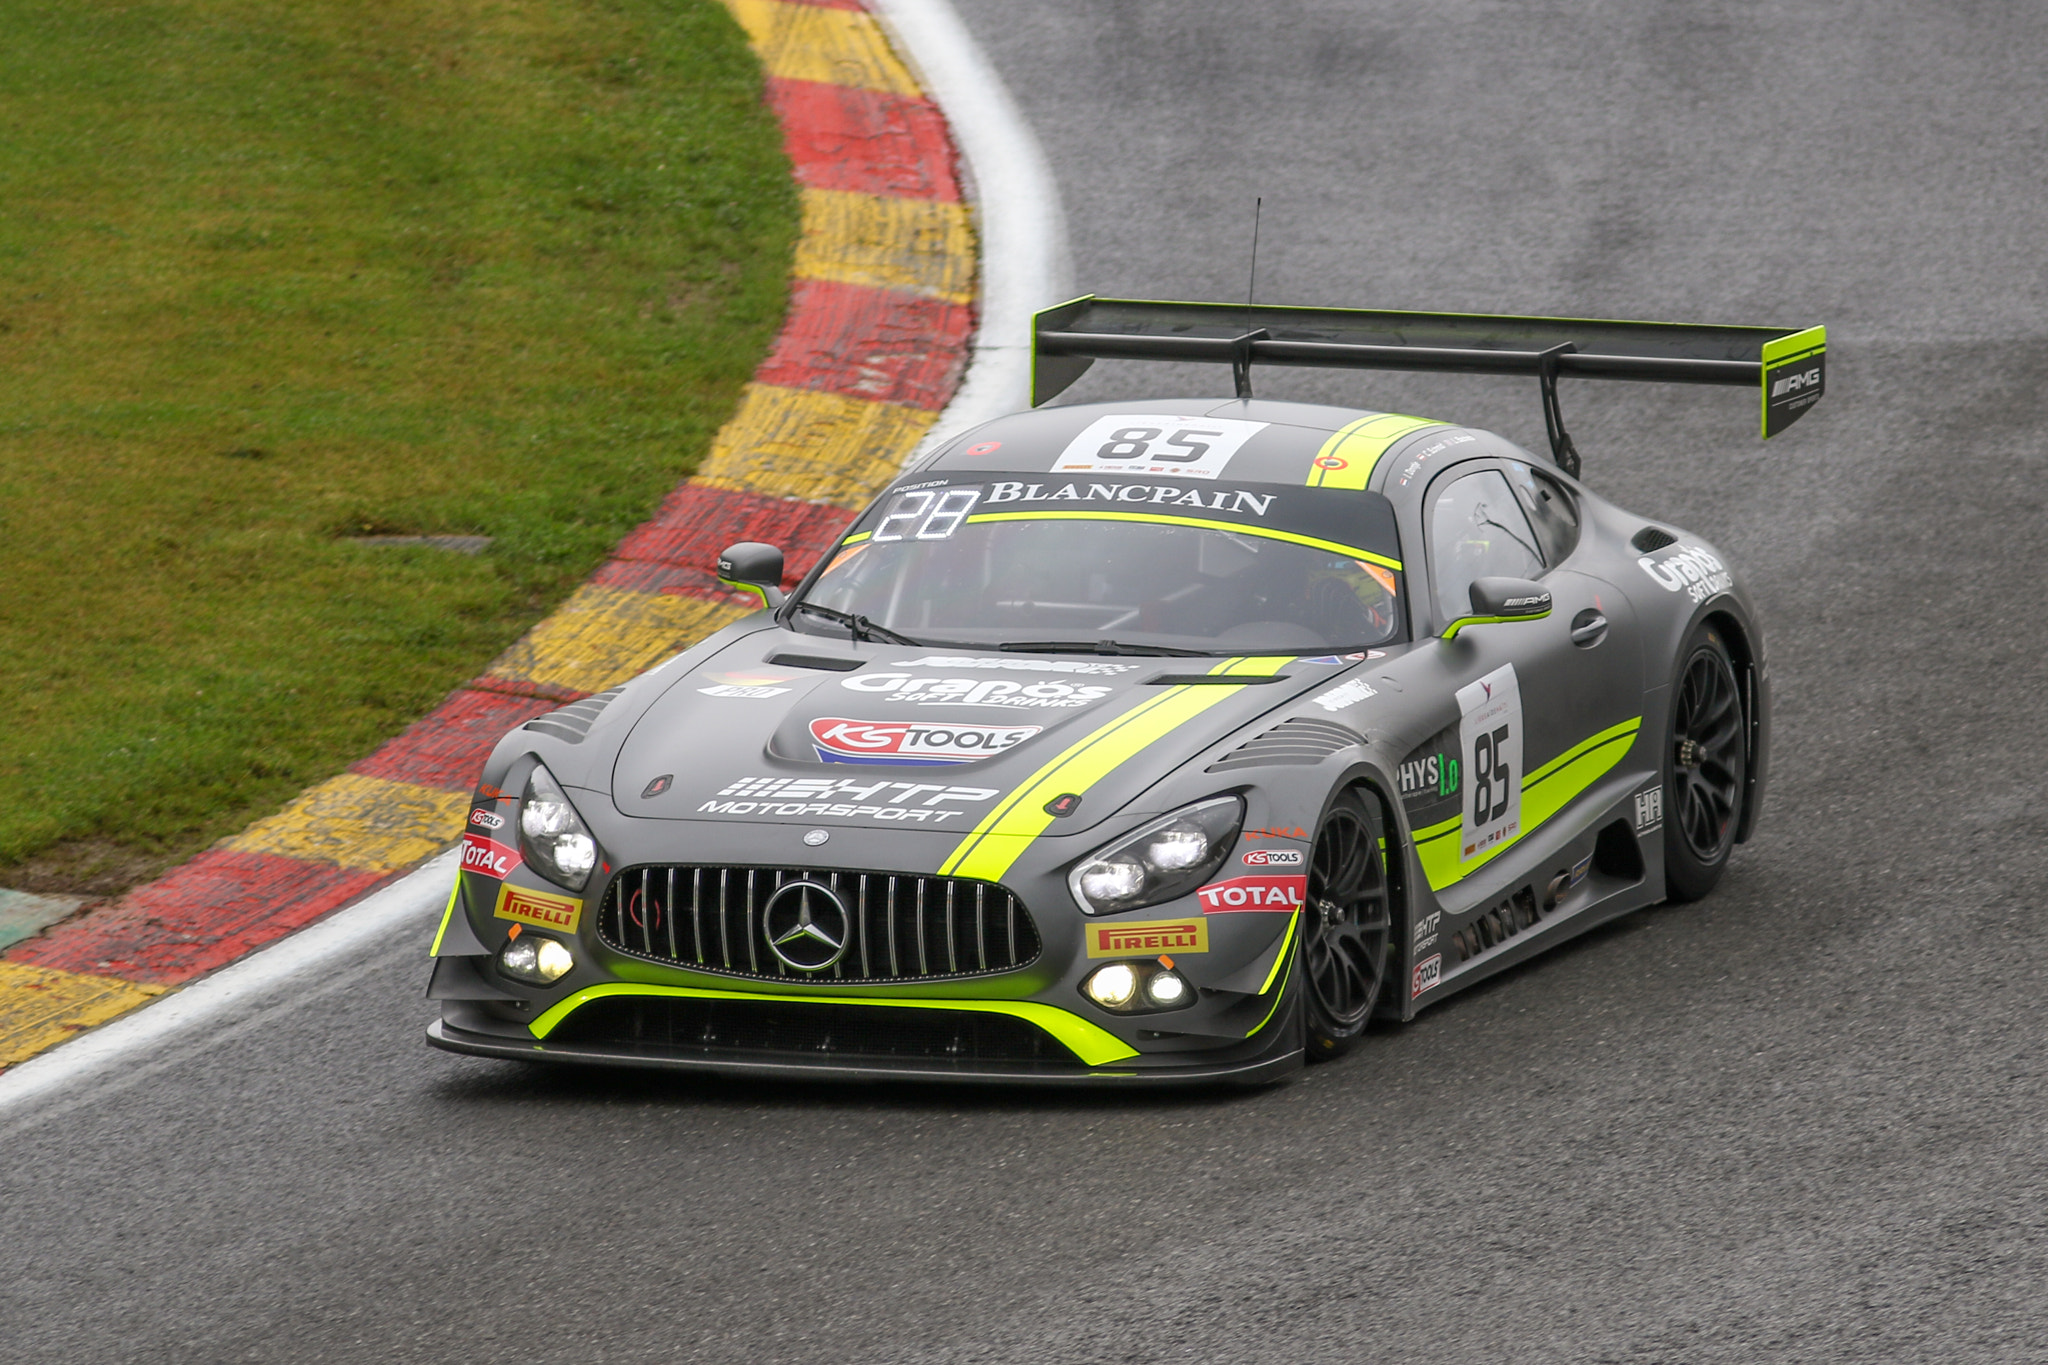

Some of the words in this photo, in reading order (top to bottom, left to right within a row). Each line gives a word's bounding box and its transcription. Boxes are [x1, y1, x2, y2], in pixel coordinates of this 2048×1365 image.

[1096, 427, 1224, 463] 85
[892, 479, 949, 494] POSITION
[982, 480, 1278, 518] BLANCPAIN
[871, 490, 982, 542] 28
[885, 691, 966, 701] SOFT
[982, 694, 1092, 708] DRINKS
[821, 723, 909, 748] KS
[906, 728, 1026, 749] TOOLS
[1473, 723, 1510, 828] 85
[478, 782, 512, 807] KUKA
[1634, 784, 1663, 830] HA
[482, 813, 501, 827] TOOLS
[696, 800, 965, 823] MOTORSPORT
[1242, 826, 1309, 842] KUKA
[461, 838, 508, 874] TOTAL
[1247, 851, 1269, 864] KS
[1267, 852, 1298, 863] TOOLS
[502, 890, 575, 926] PIRELLI
[1198, 886, 1304, 907] TOTAL
[1098, 924, 1197, 951] PIRELLI
